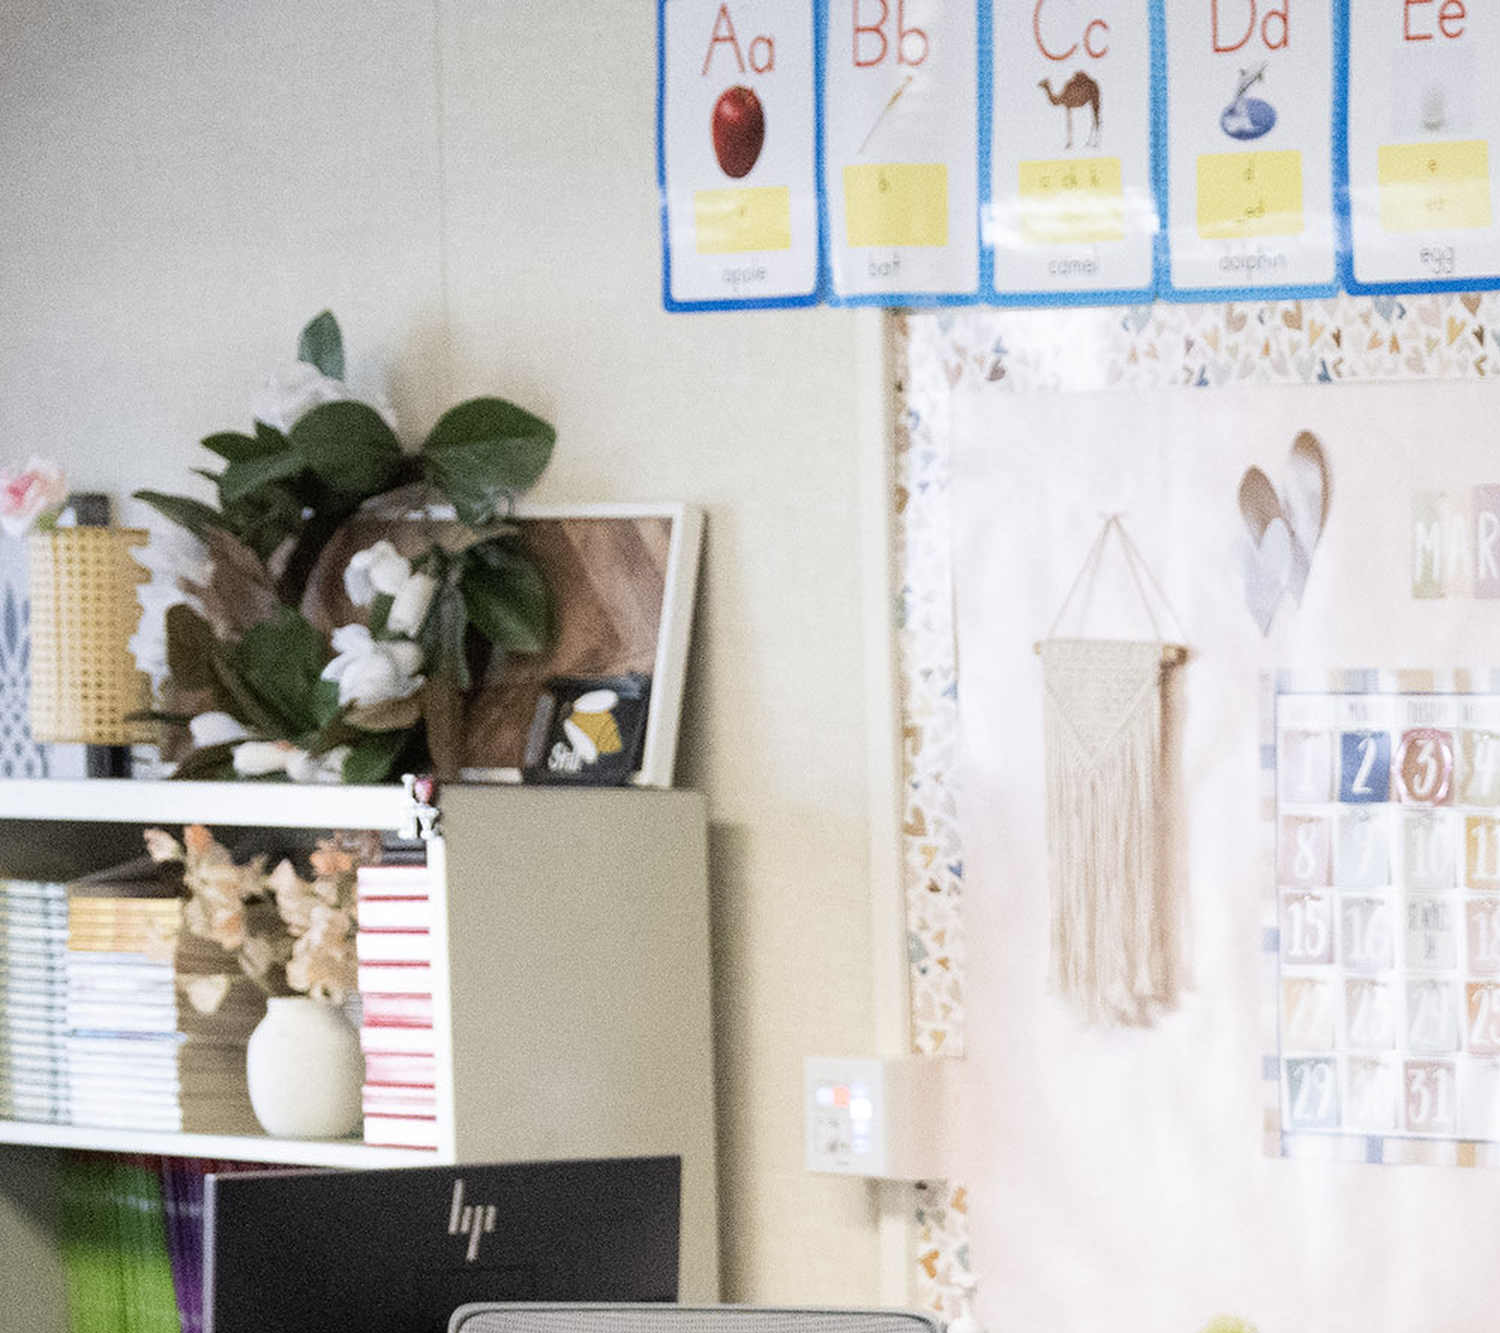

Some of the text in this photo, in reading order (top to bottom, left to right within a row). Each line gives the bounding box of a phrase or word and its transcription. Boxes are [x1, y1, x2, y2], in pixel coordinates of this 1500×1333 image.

[703, 2, 776, 76] Aa
[852, 0, 929, 67] Bb
[1033, 0, 1109, 61] Cc
[1211, 0, 1290, 53] Dd
[1351, 737, 1377, 794] 2
[1412, 740, 1437, 795] 3
[1295, 821, 1315, 879] 8
[1287, 900, 1328, 956] 15
[1288, 1063, 1448, 1122] 29 31
[448, 1179, 498, 1262] hp
